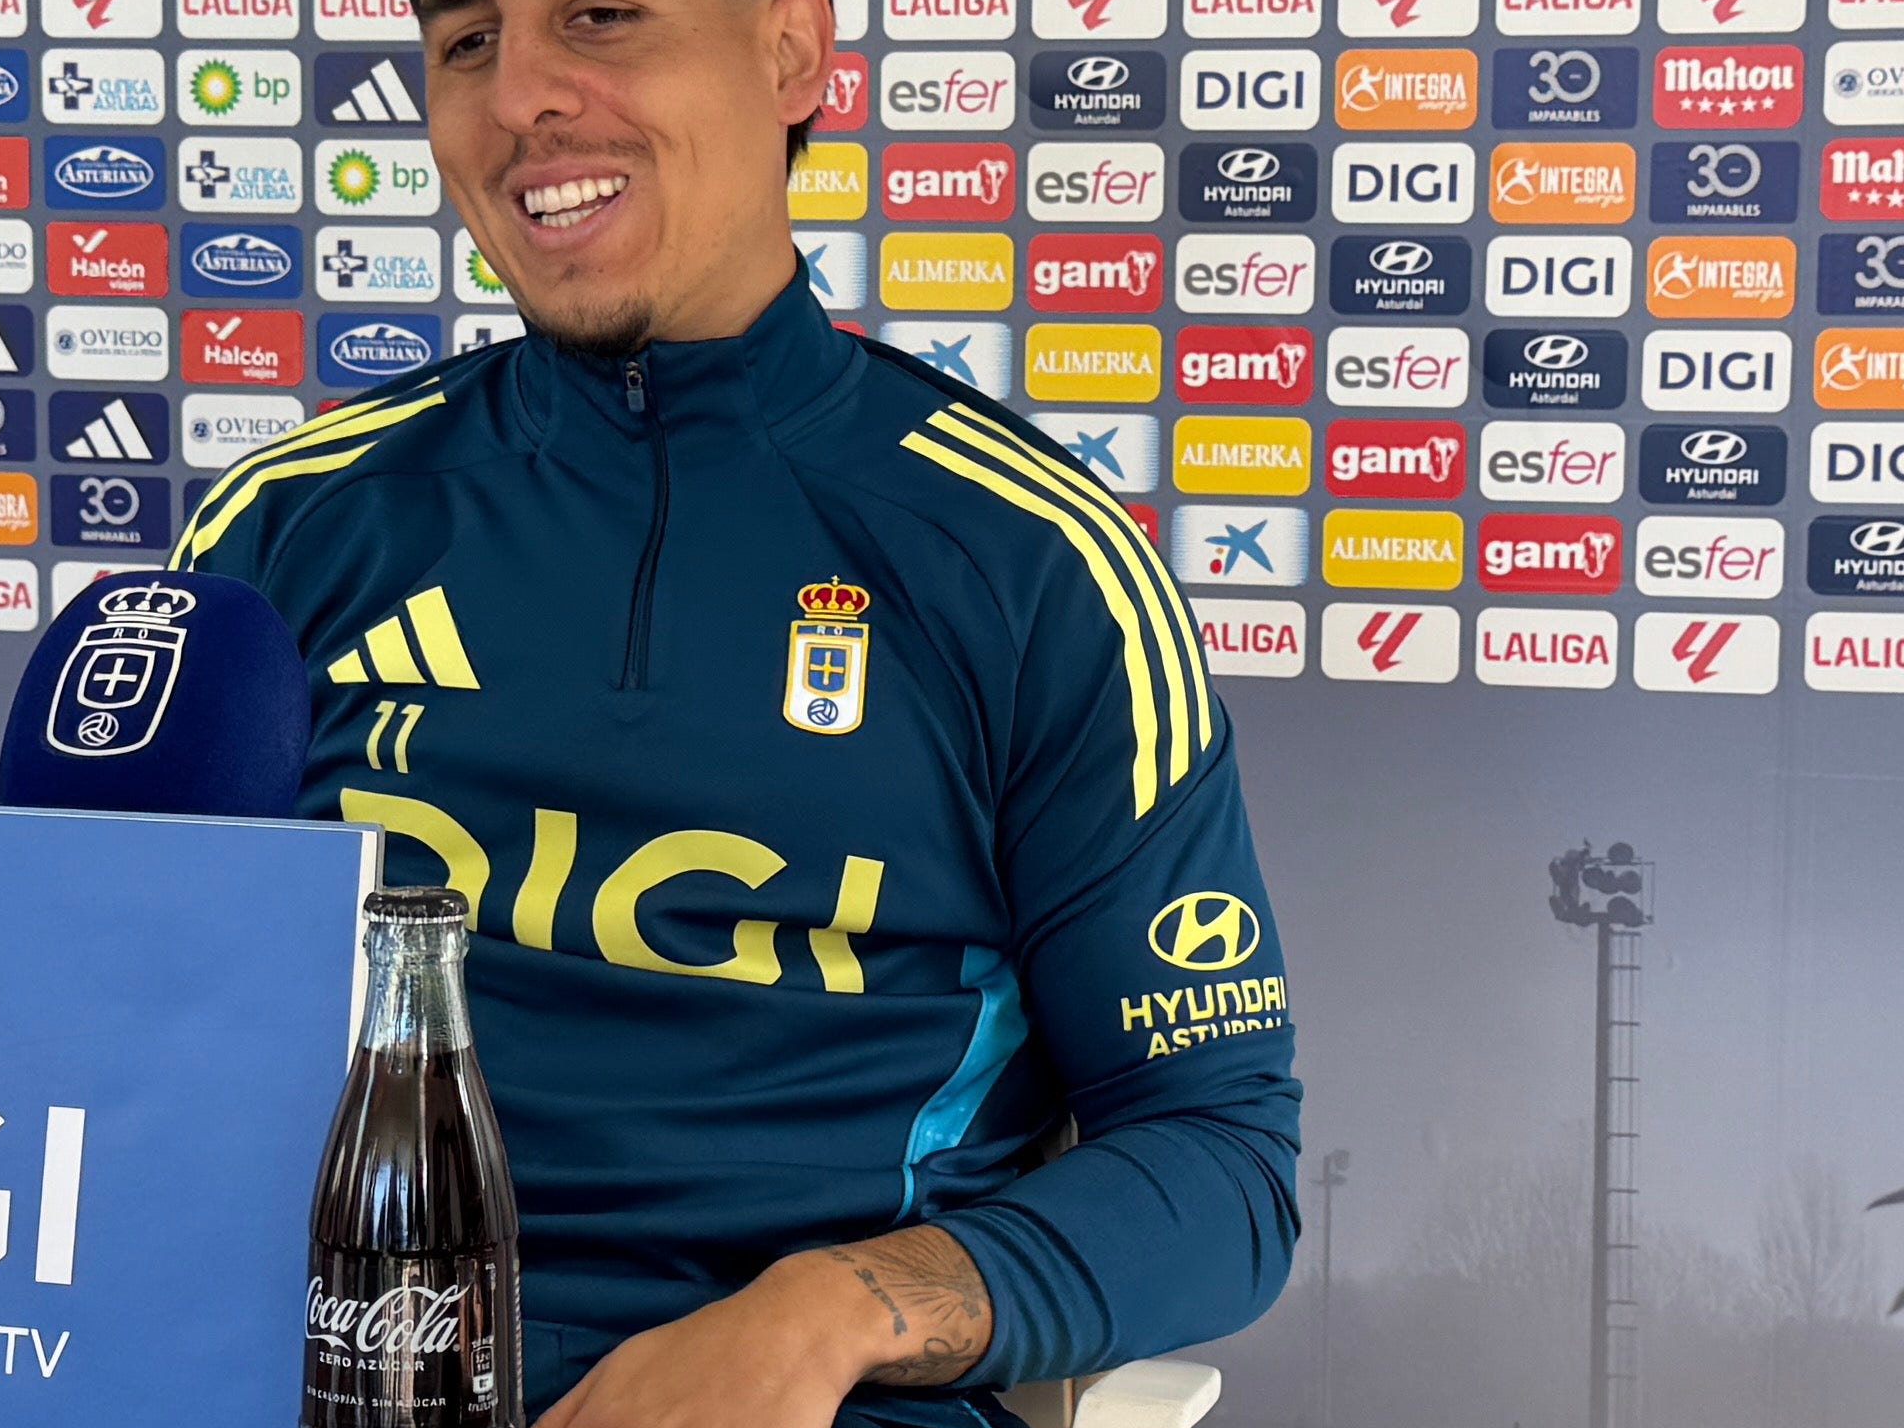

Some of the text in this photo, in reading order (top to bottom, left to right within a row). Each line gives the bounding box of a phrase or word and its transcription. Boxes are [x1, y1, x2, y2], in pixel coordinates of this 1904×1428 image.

[1195, 71, 1304, 109] DIGI
[392, 161, 429, 193] bp
[1539, 167, 1624, 195] INTEGRA
[205, 344, 278, 366] Halcón
[1181, 441, 1302, 469] ALIMERKA
[1487, 438, 1616, 486] esfer
[1120, 975, 1287, 1032] HYUNDAI
[305, 1275, 473, 1355] Coca-Cola
[318, 1350, 352, 1368] ZERO
